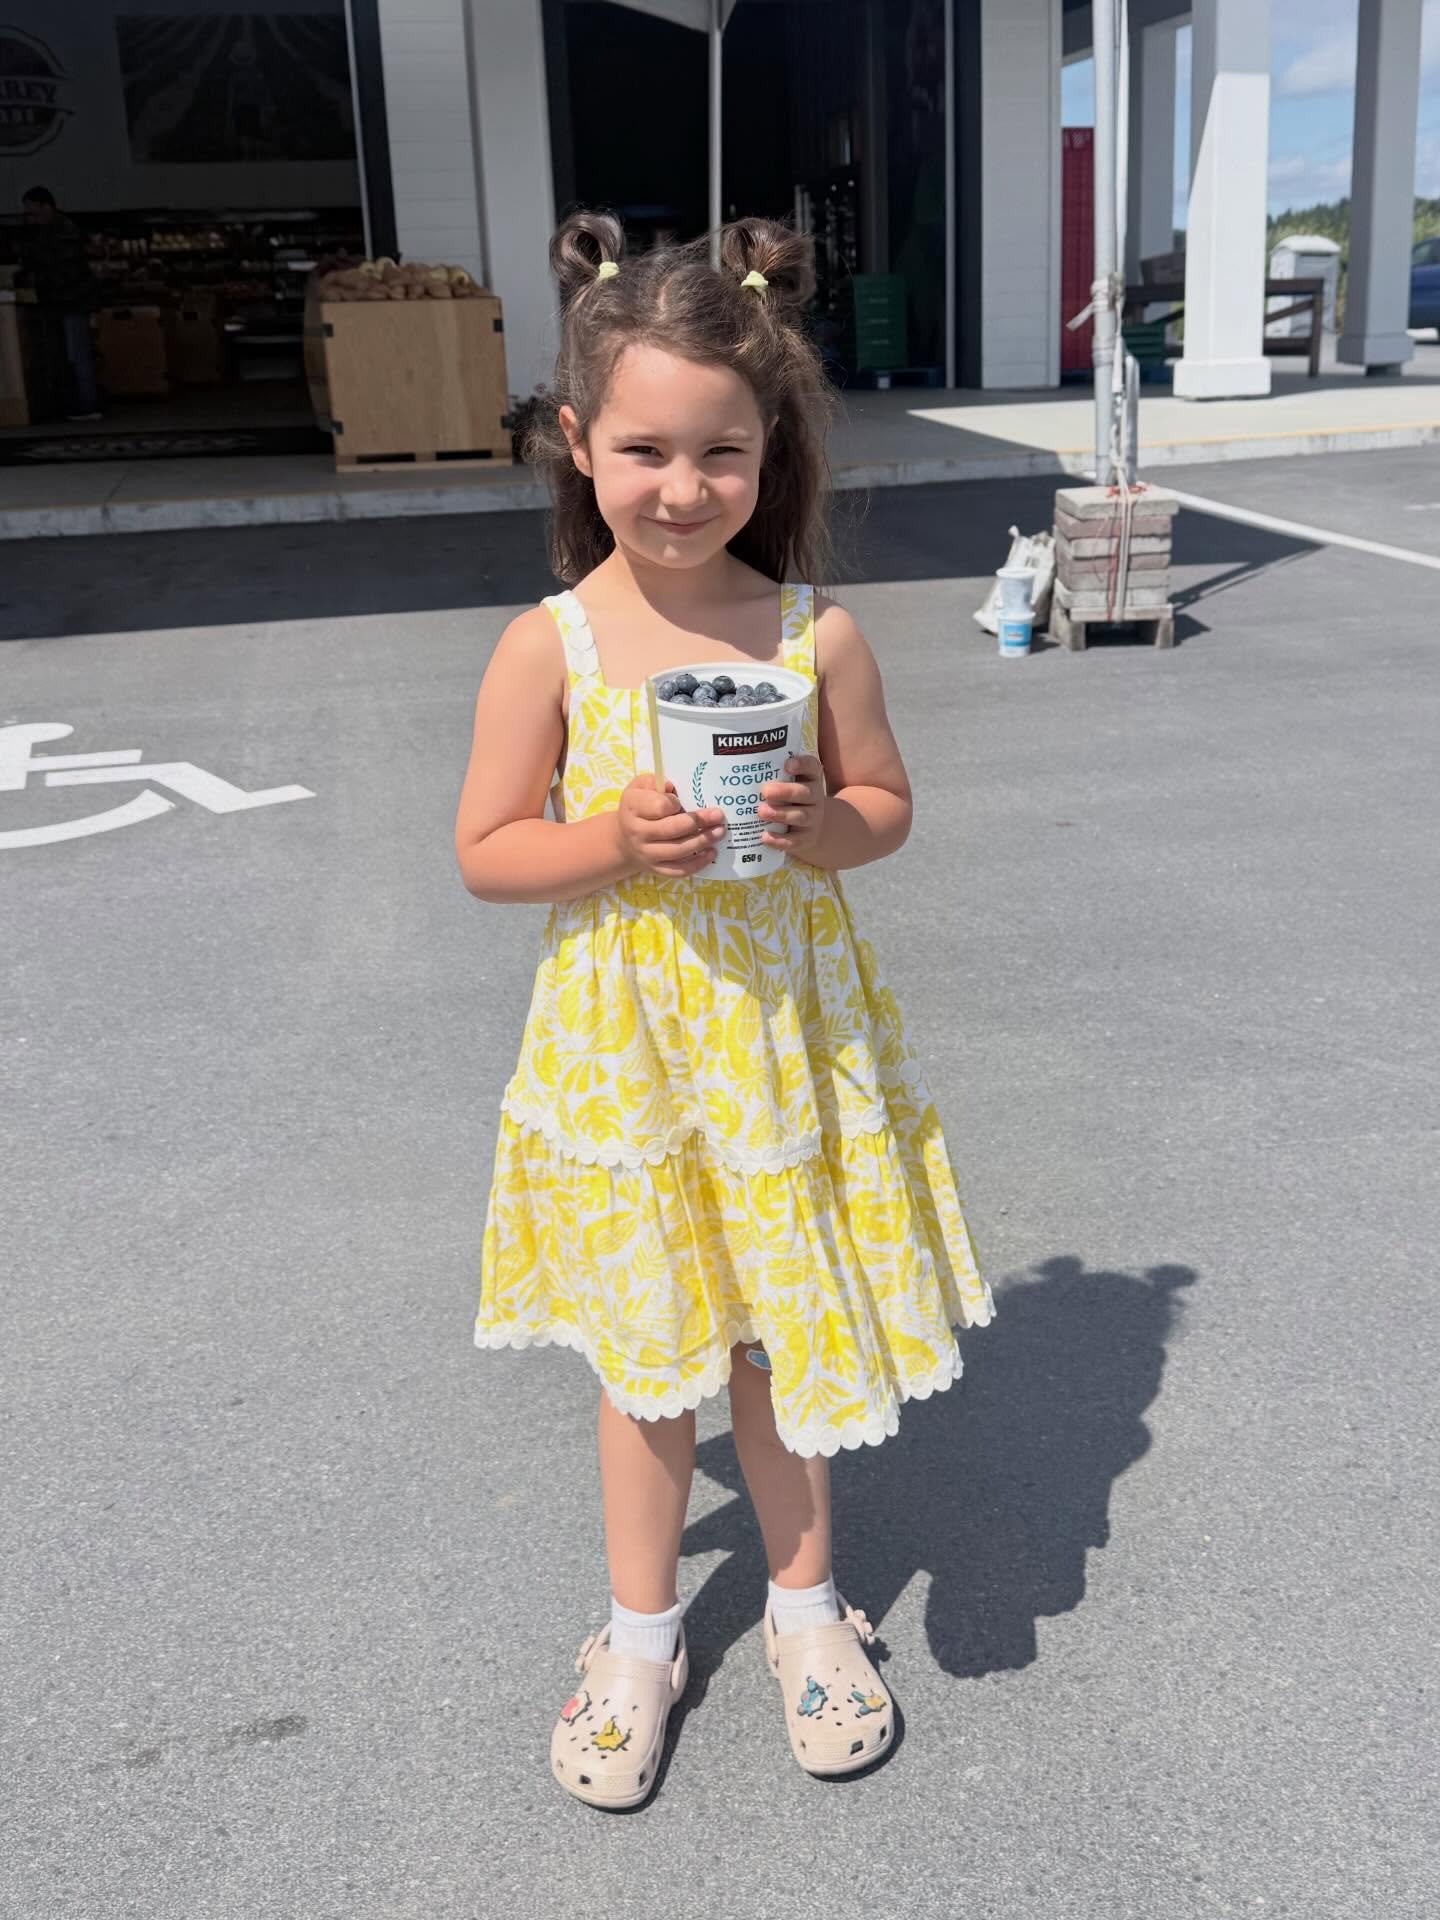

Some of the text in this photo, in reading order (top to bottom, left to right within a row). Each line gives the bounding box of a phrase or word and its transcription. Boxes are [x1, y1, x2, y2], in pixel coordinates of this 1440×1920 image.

[718, 729, 786, 747] KIRKLAND
[732, 761, 772, 773] GREEK
[719, 769, 781, 785] YOGURT
[714, 793, 766, 805] YOGOU
[736, 806, 759, 816] GRE
[742, 853, 756, 863] 650
